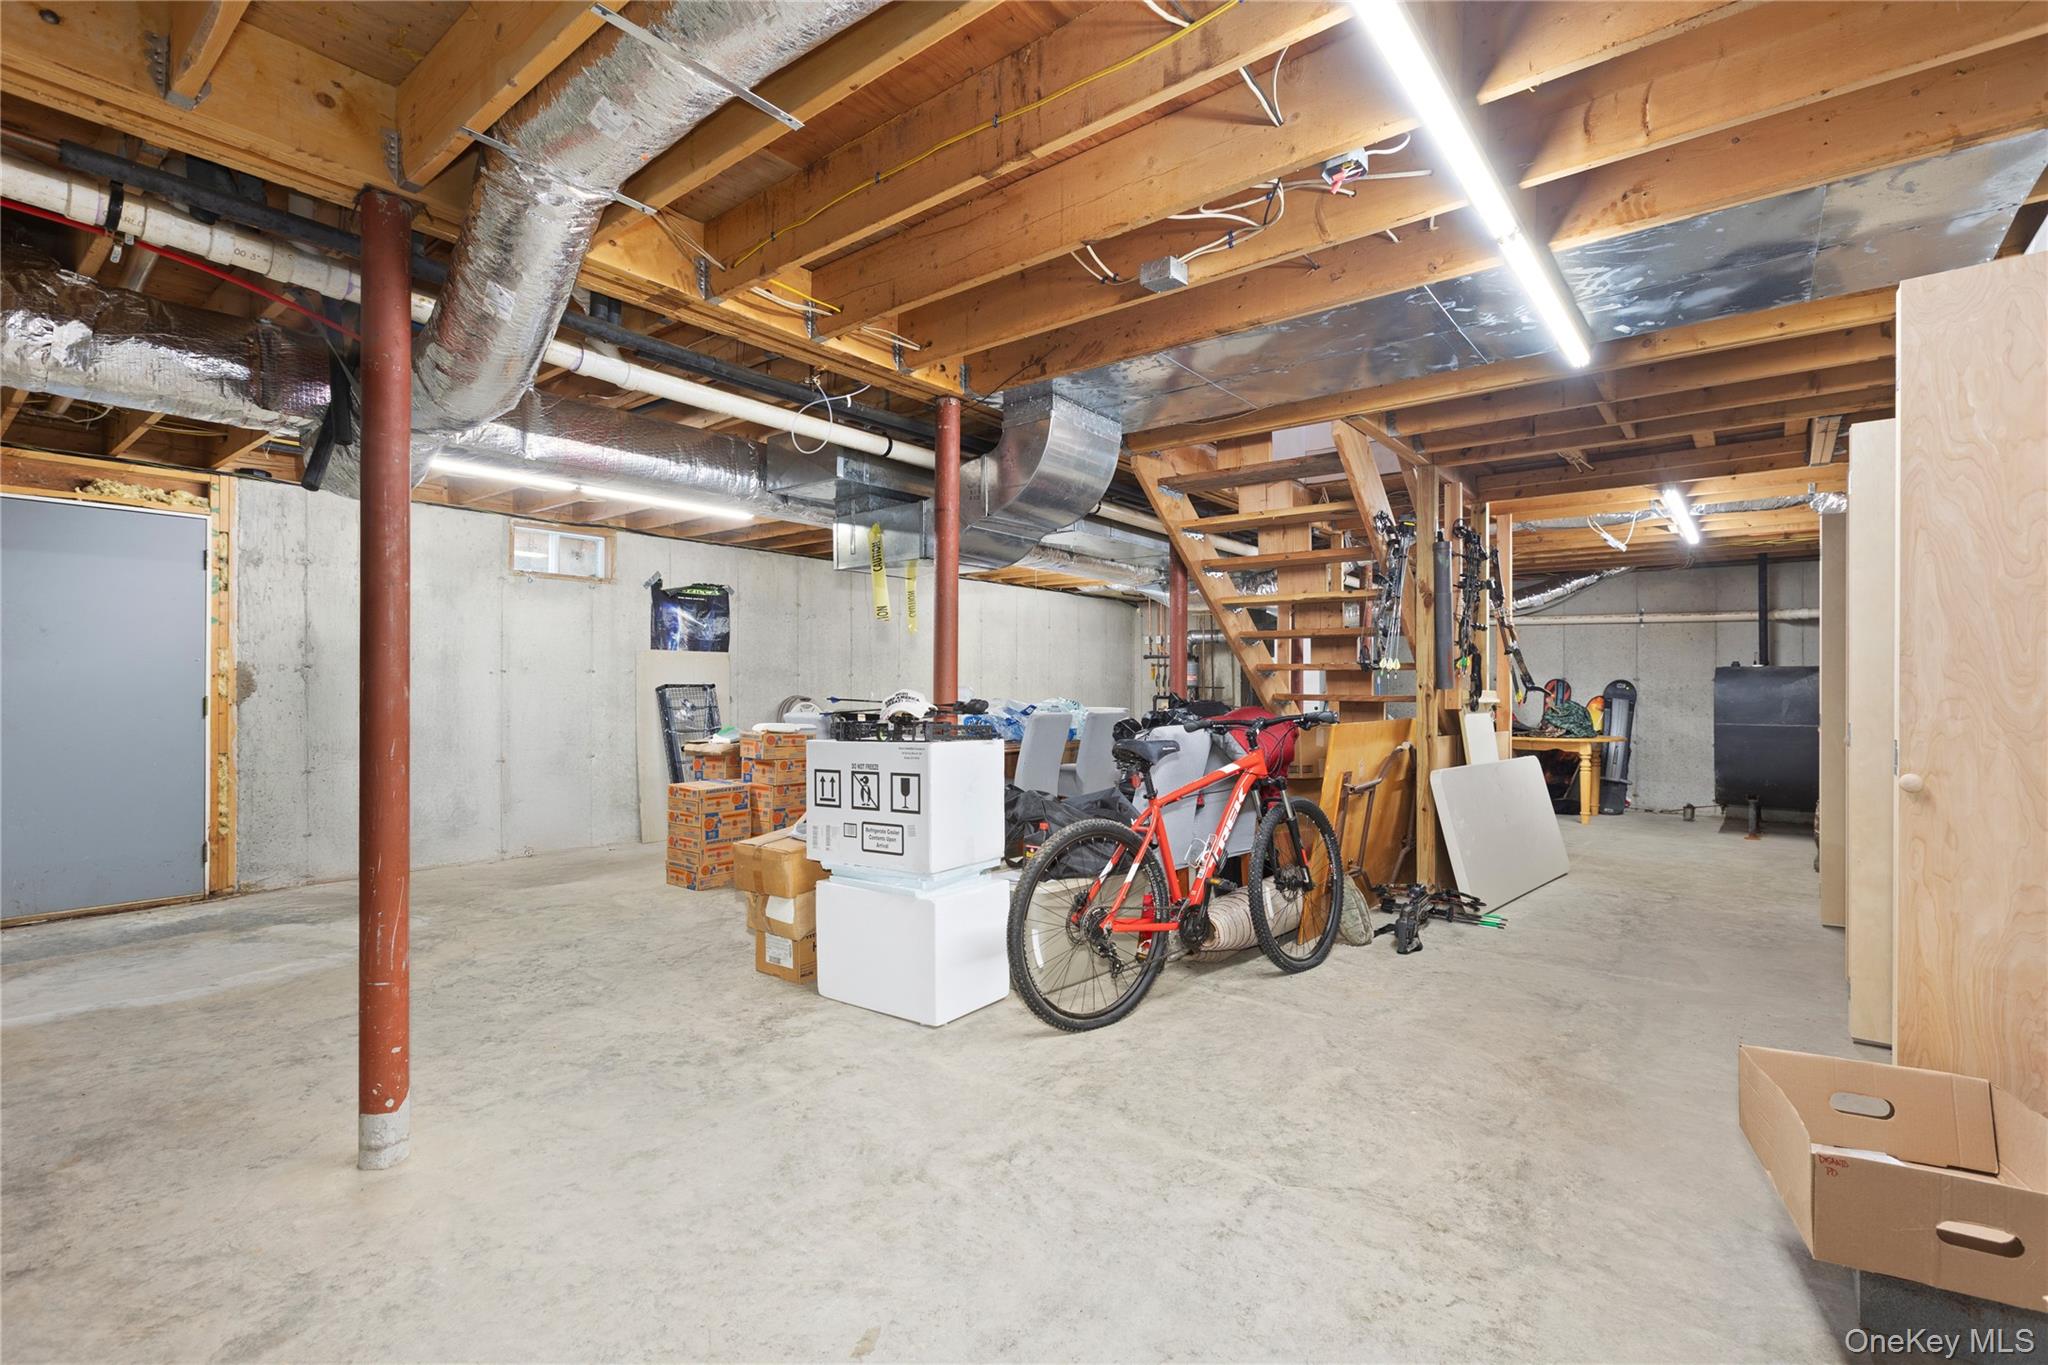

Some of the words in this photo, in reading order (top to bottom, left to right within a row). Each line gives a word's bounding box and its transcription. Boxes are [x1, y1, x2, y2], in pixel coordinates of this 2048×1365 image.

[871, 540, 883, 572] CAUTION
[876, 605, 889, 622] ION
[865, 763, 879, 771] FREEZE
[1207, 787, 1248, 868] TREK
[868, 834, 886, 842] Contents
